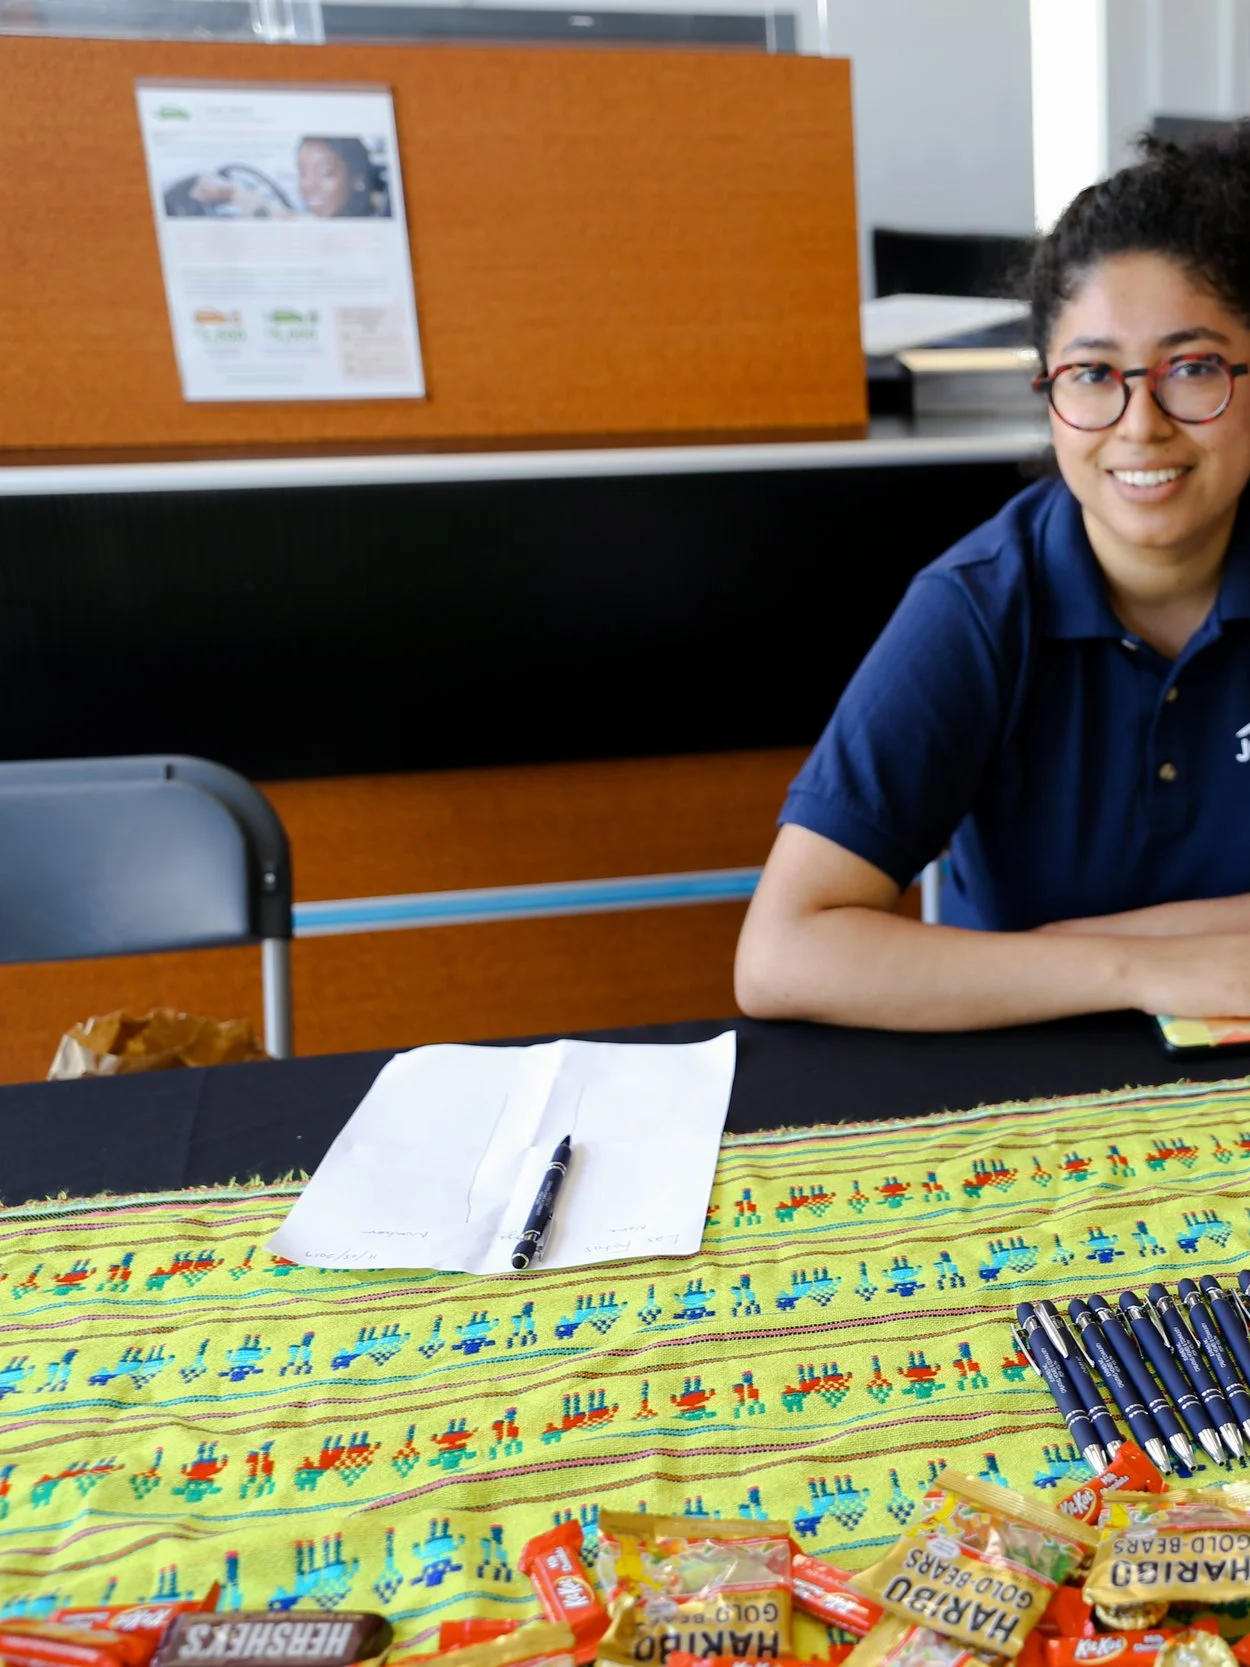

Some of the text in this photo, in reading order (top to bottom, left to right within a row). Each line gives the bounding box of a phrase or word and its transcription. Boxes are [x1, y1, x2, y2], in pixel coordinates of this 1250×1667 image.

[1111, 1556, 1250, 1587] HARIBO
[884, 1575, 1020, 1644] HARIBO
[180, 1621, 354, 1658] HERSHEY'S
